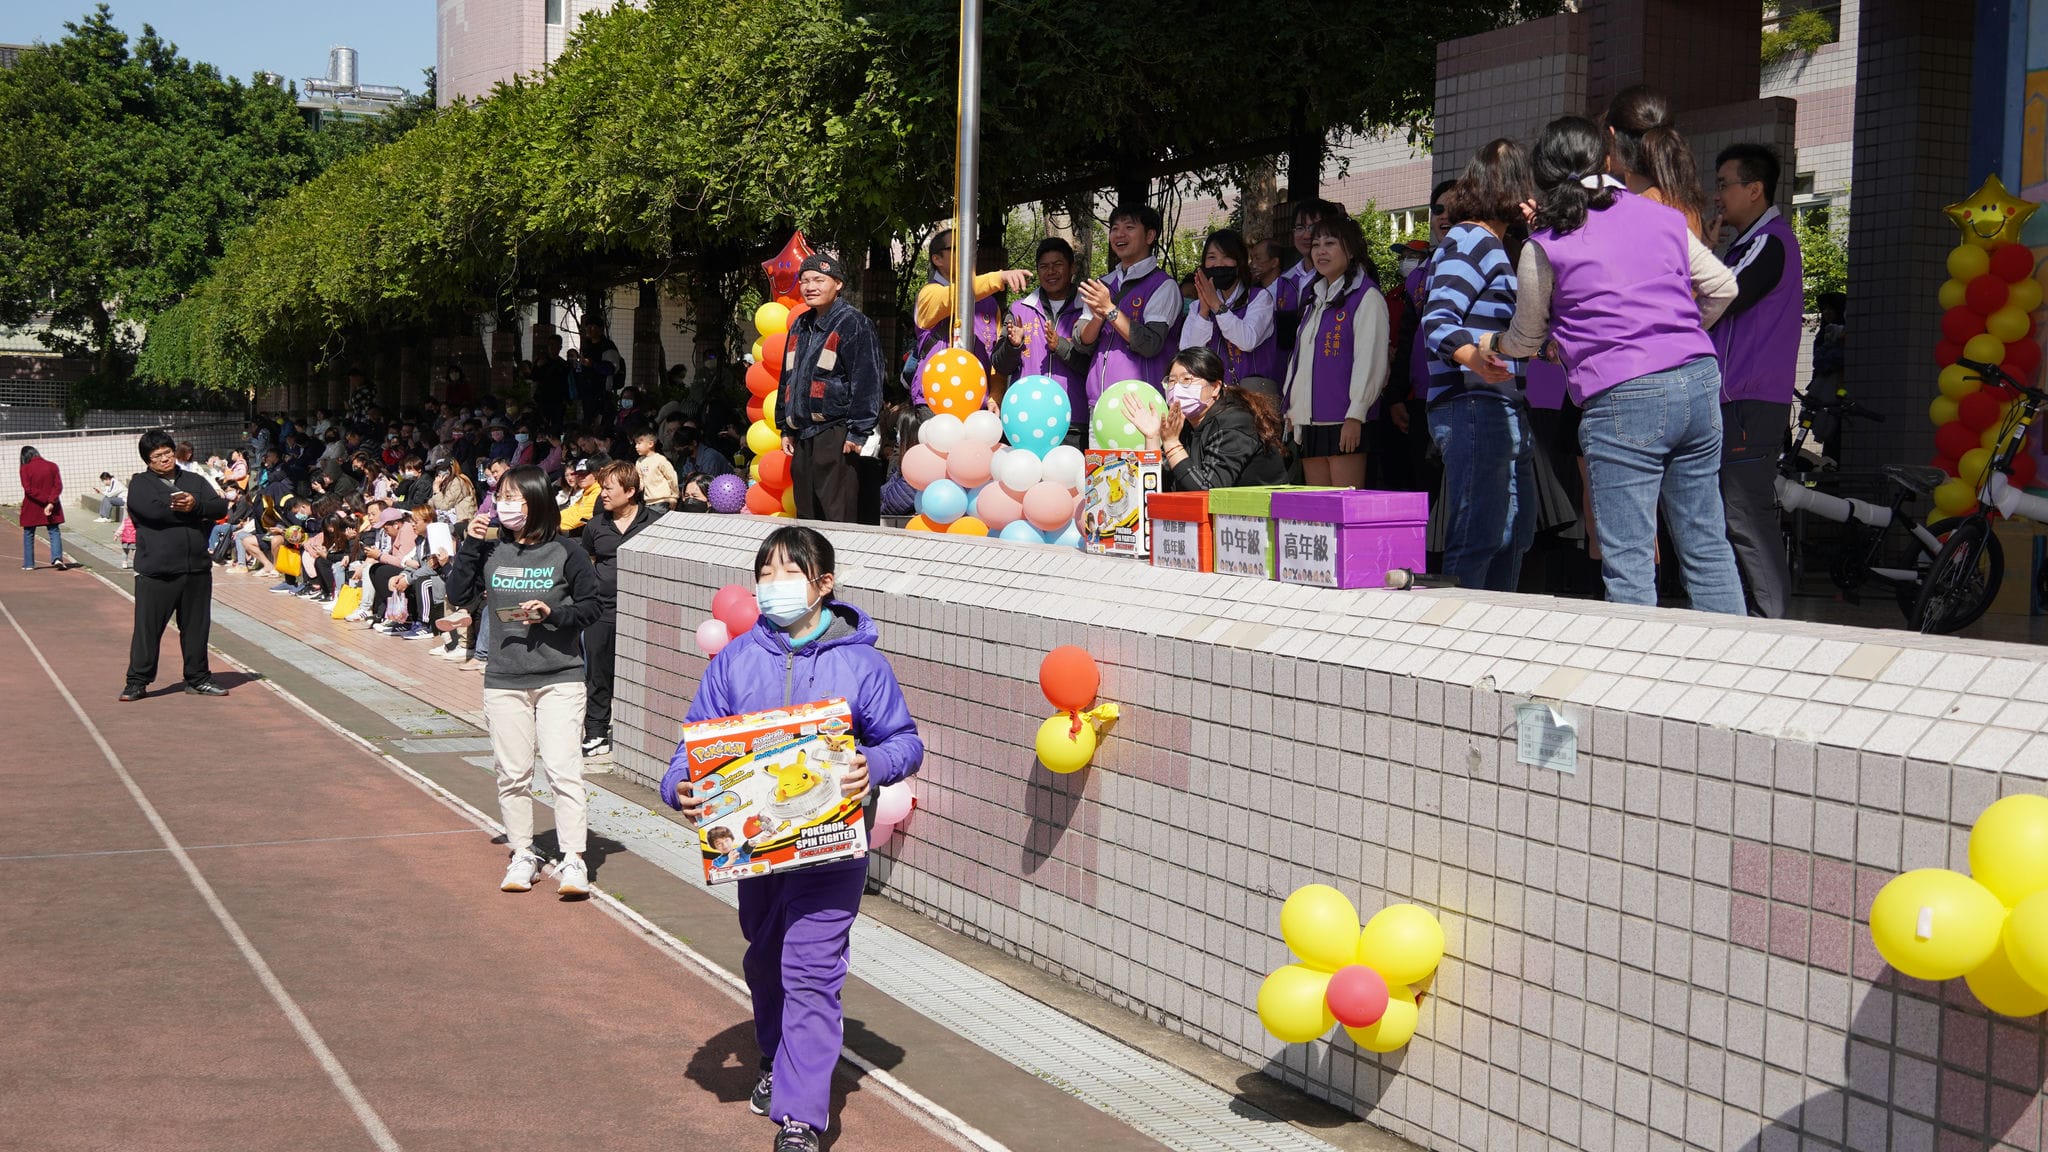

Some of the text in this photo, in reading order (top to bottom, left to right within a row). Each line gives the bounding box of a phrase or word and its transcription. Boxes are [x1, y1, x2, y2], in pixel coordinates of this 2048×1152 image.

[1163, 539, 1186, 556] 低年級
[1220, 527, 1260, 556] 中年級
[1284, 532, 1329, 562] 高年級
[491, 574, 554, 589] balance
[524, 567, 555, 578] new
[795, 830, 855, 849] SPIN FIGHTER
